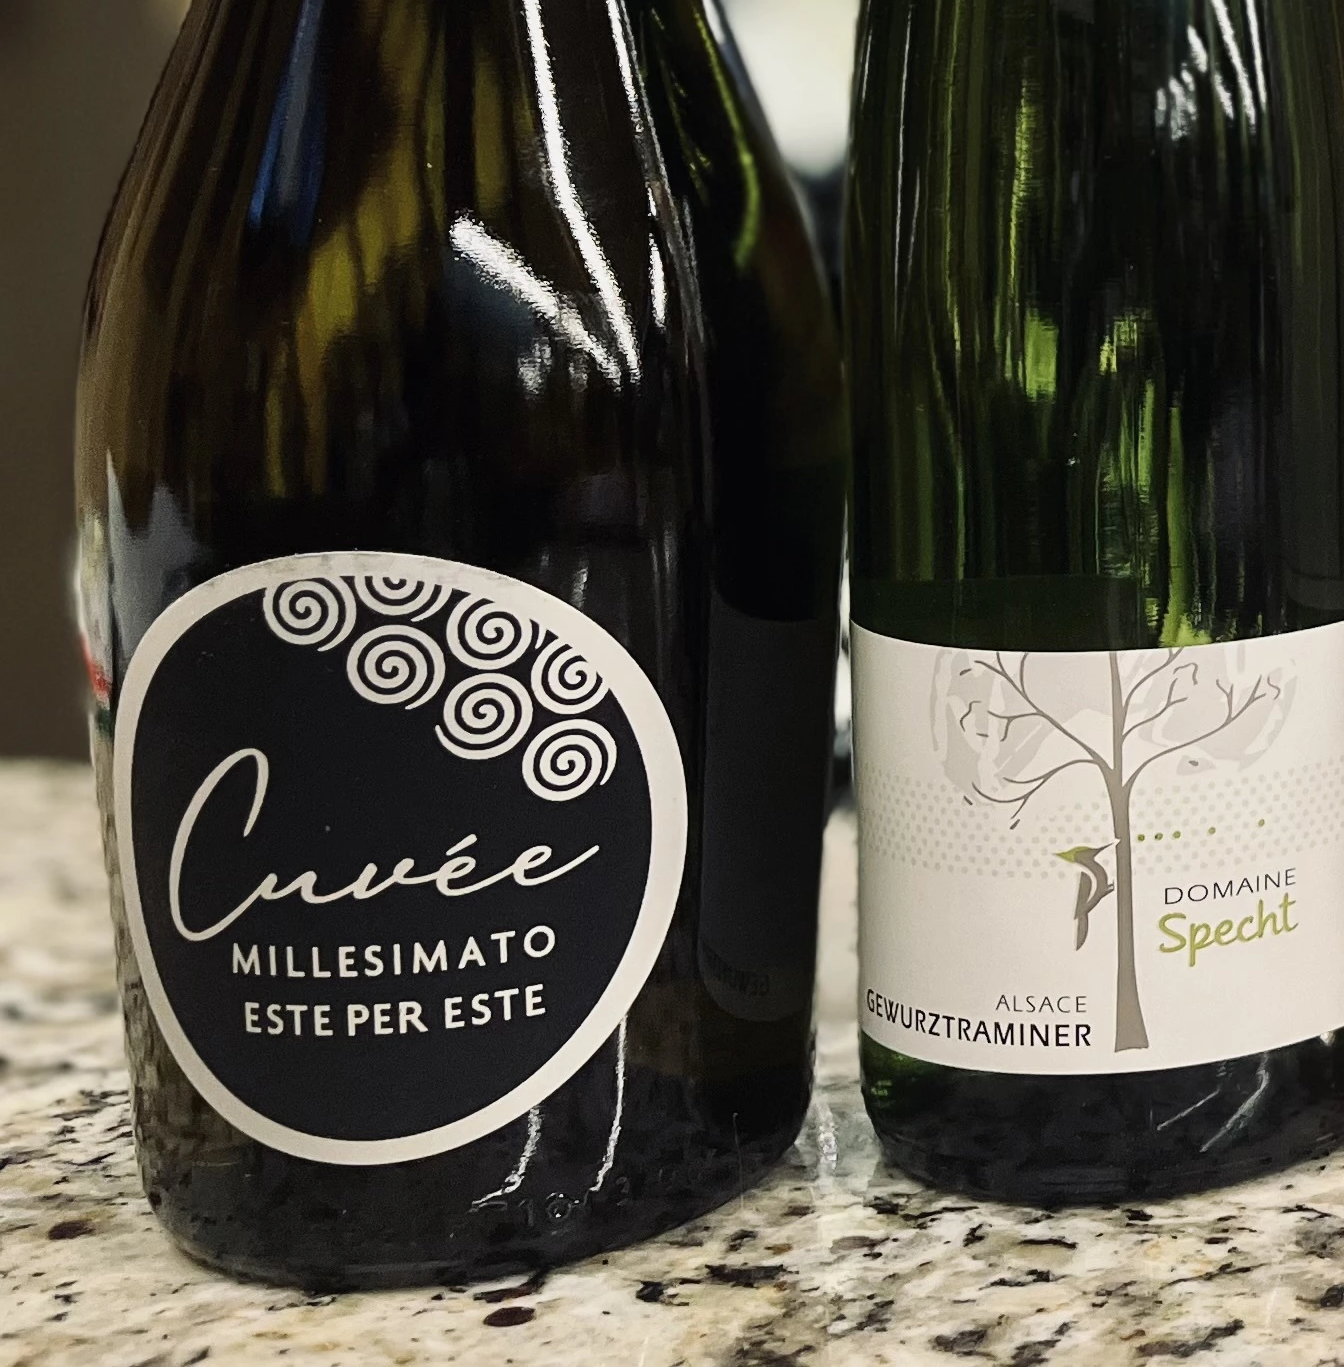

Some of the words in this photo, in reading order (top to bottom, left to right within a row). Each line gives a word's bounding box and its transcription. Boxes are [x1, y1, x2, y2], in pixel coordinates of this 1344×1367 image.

[168, 747, 600, 941] Cuvée
[1164, 867, 1297, 905] DOMAINE
[231, 925, 557, 978] MILLESIMATO
[1157, 892, 1300, 967] Specht
[244, 1001, 334, 1037] ESTE
[346, 1001, 430, 1037] PER
[443, 983, 547, 1030] ESTE
[866, 987, 1092, 1047] GEWURZTRAMINER
[995, 994, 1088, 1014] ALSACE
